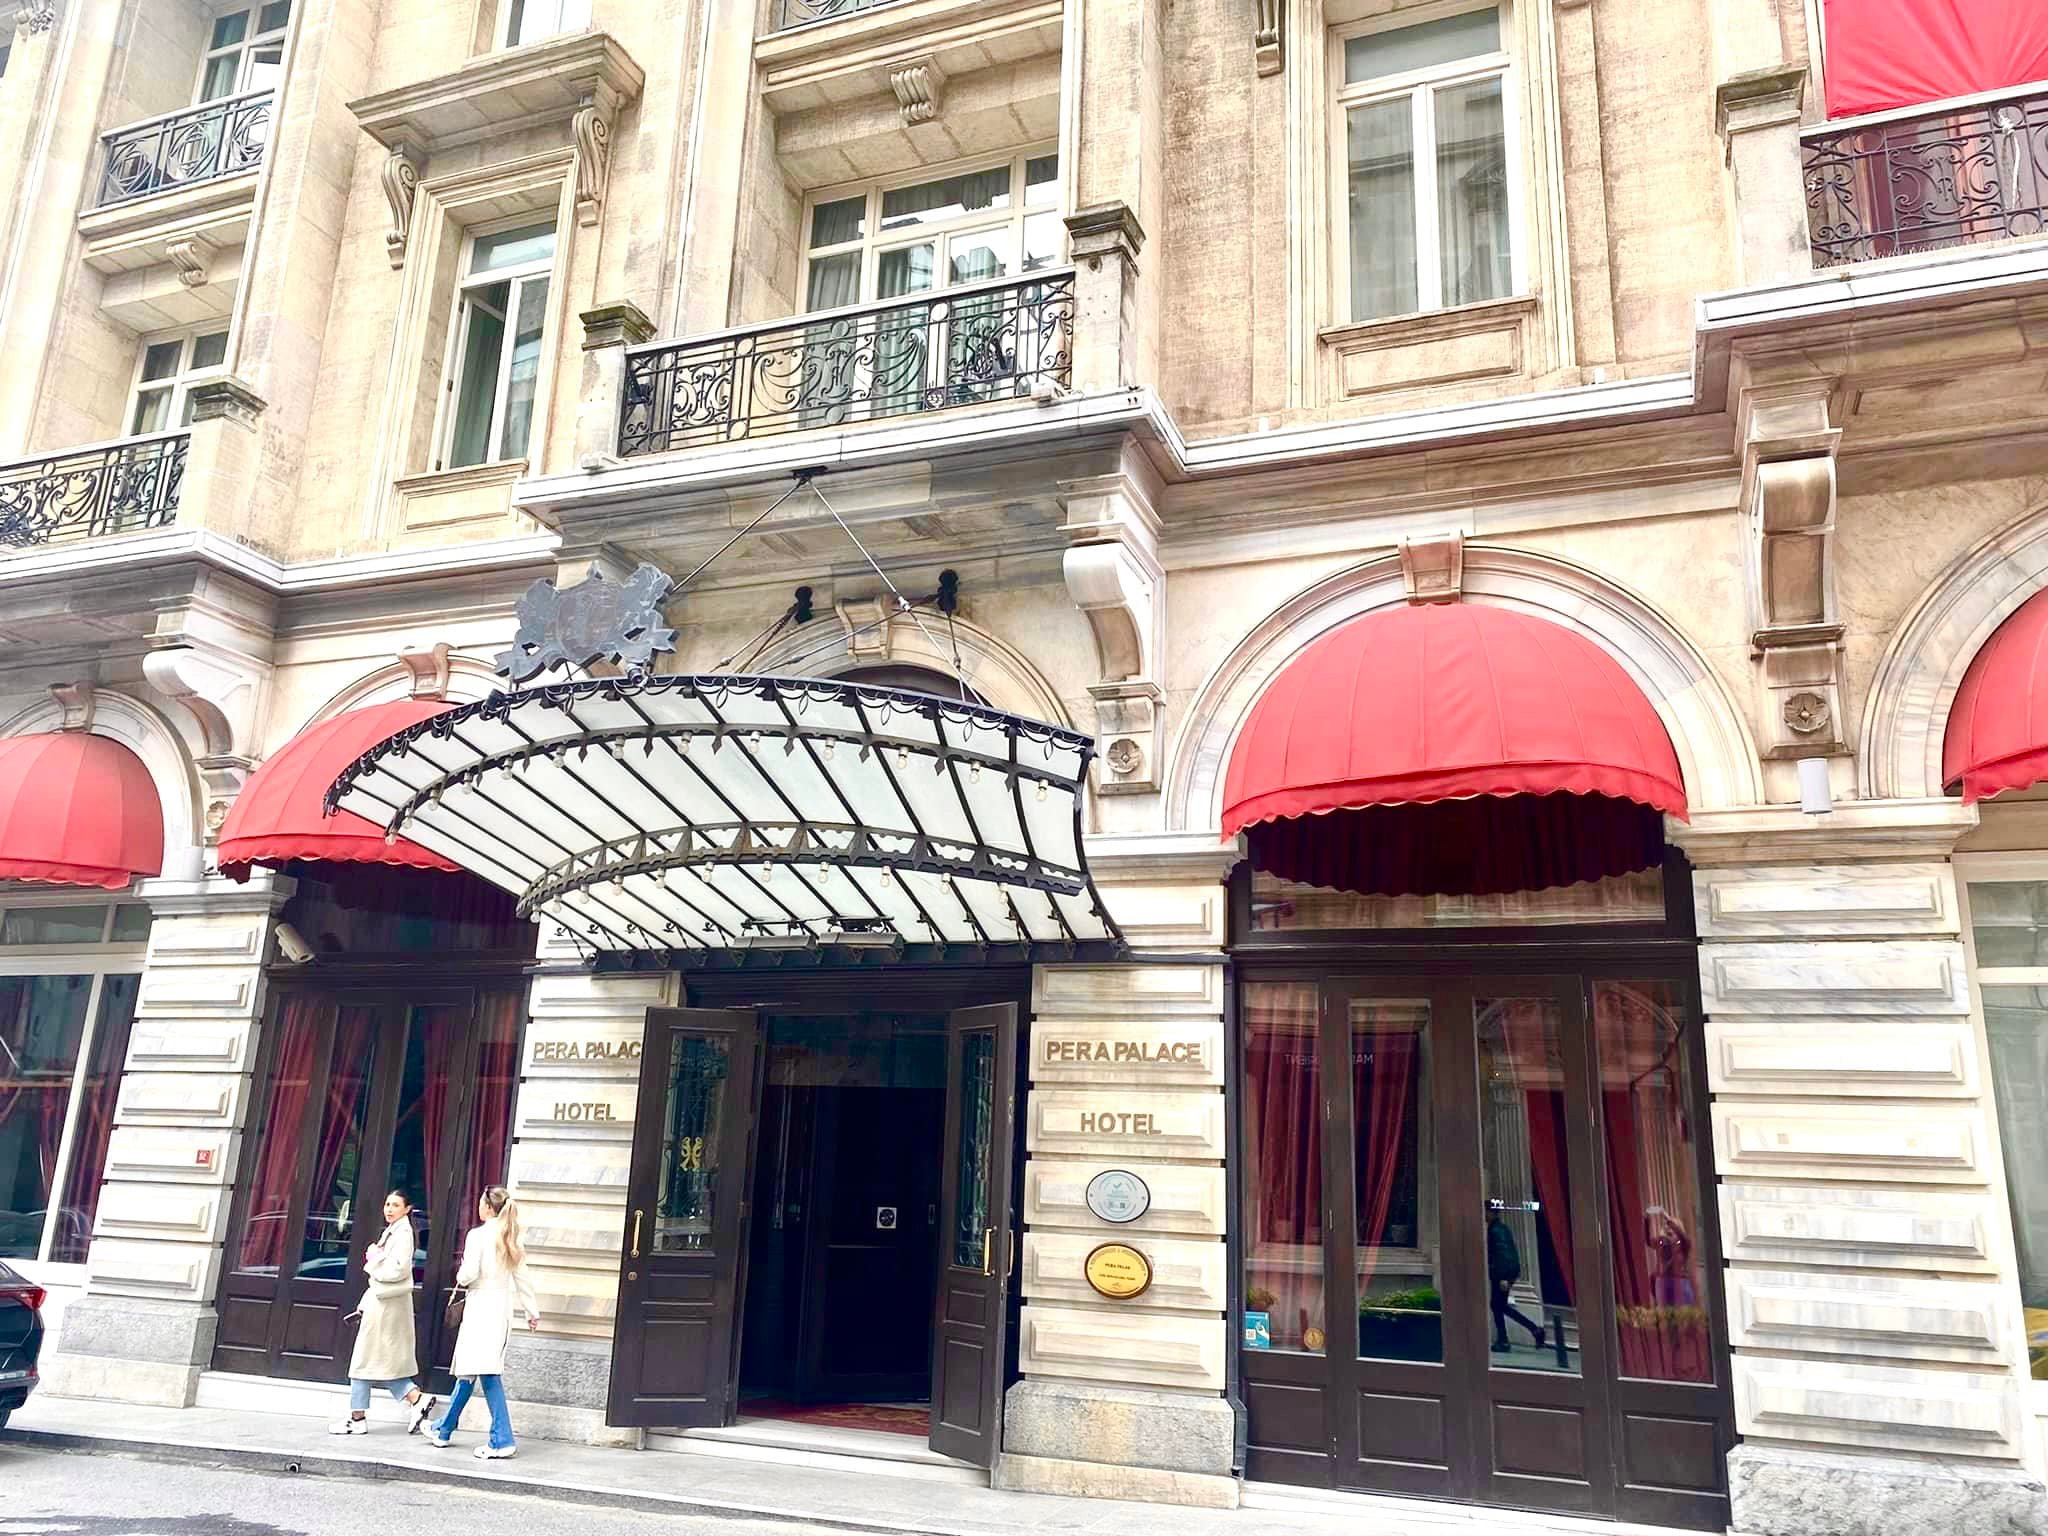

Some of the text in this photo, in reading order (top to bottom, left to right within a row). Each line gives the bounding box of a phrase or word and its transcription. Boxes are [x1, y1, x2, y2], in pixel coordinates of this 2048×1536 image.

[533, 1041, 641, 1059] PERA PALAC
[1046, 1041, 1201, 1063] PERA PALACE
[553, 1102, 617, 1121] HOTEL
[1080, 1112, 1162, 1134] HOTEL
